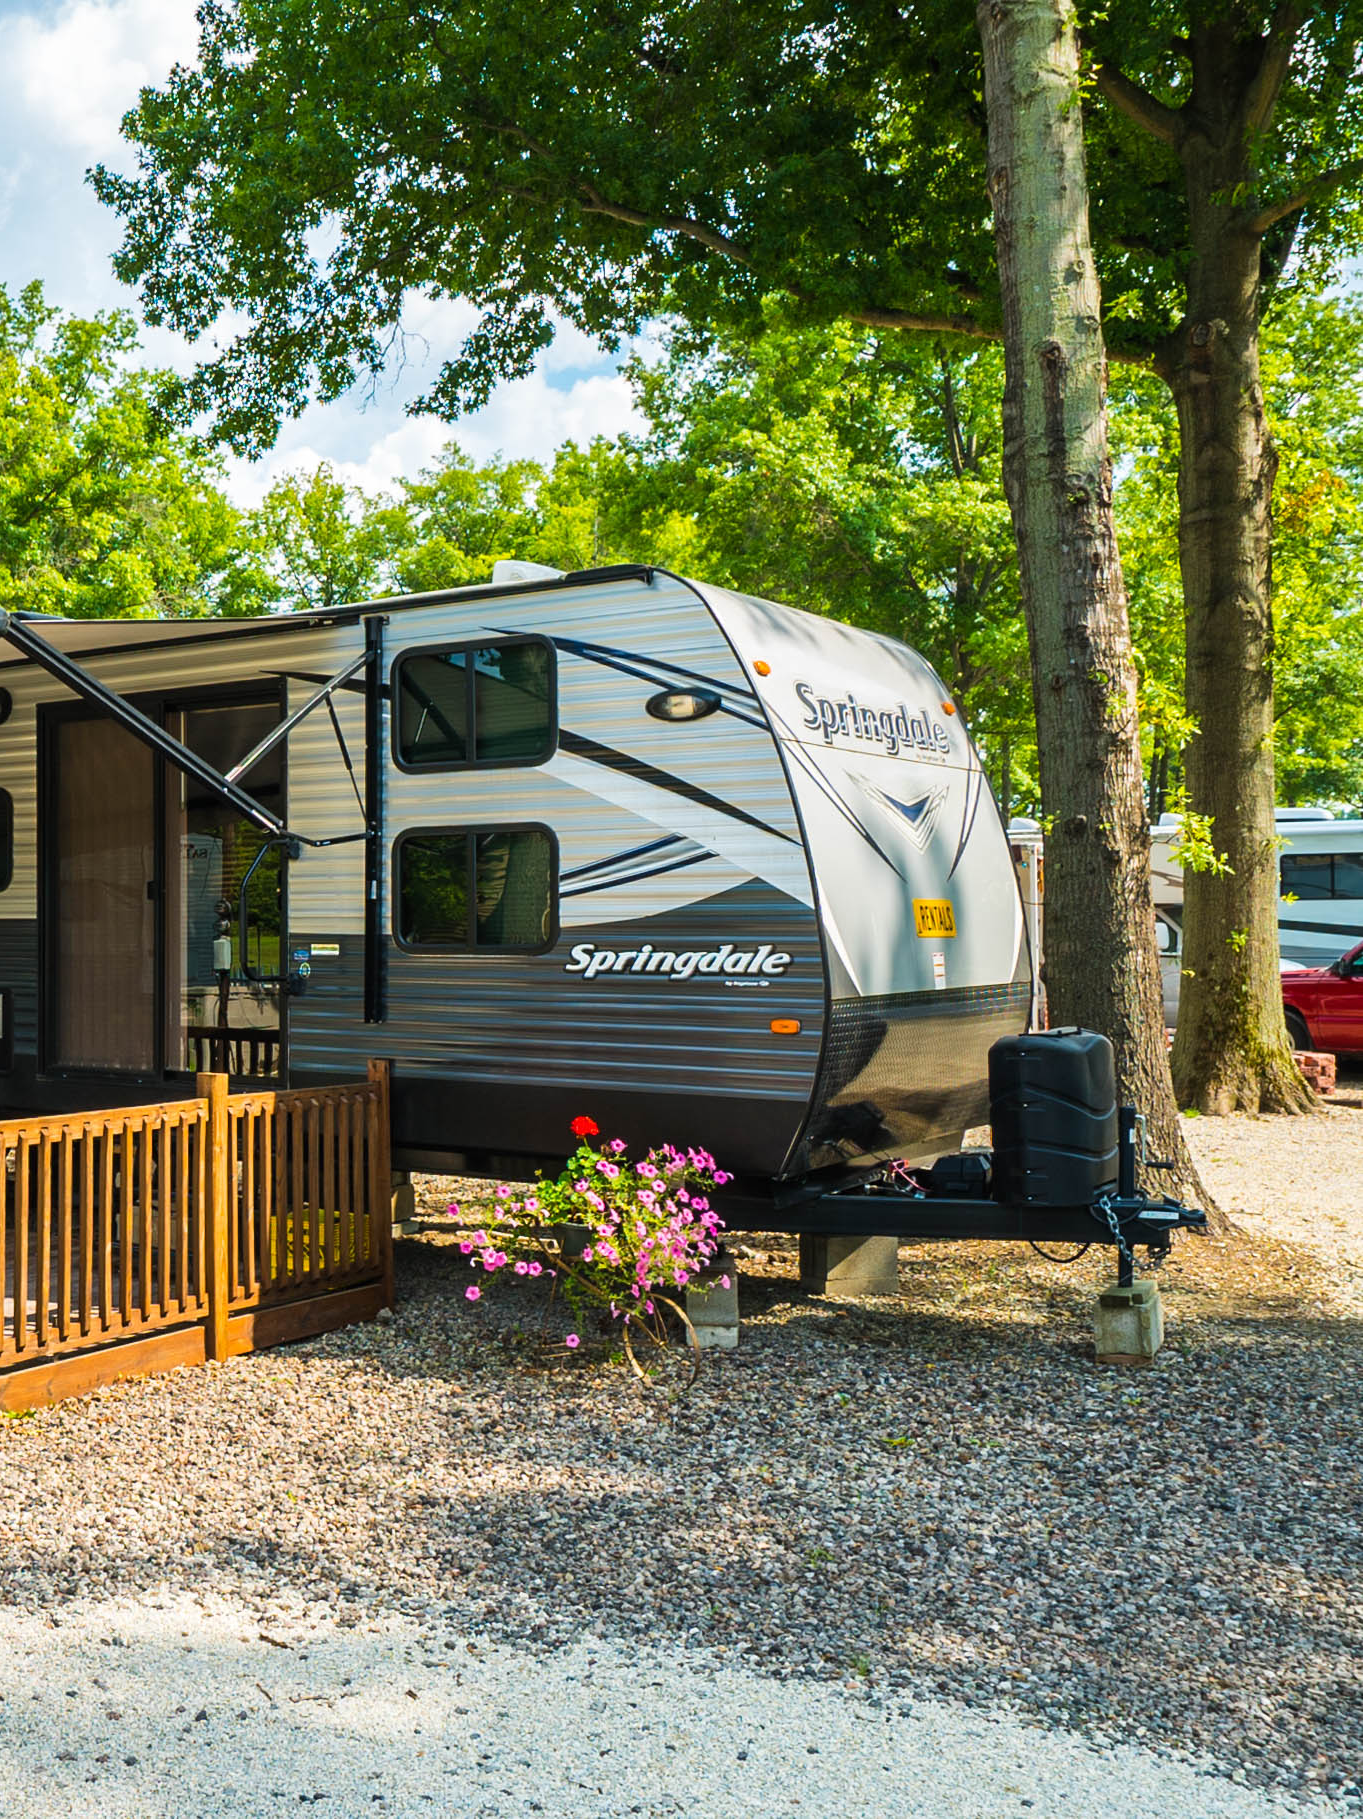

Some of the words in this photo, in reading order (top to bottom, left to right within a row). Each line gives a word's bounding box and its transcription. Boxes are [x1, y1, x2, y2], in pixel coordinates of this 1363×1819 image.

[795, 681, 950, 755] Springdale
[919, 905, 954, 931] RENTALS
[564, 943, 793, 979] Springdale
